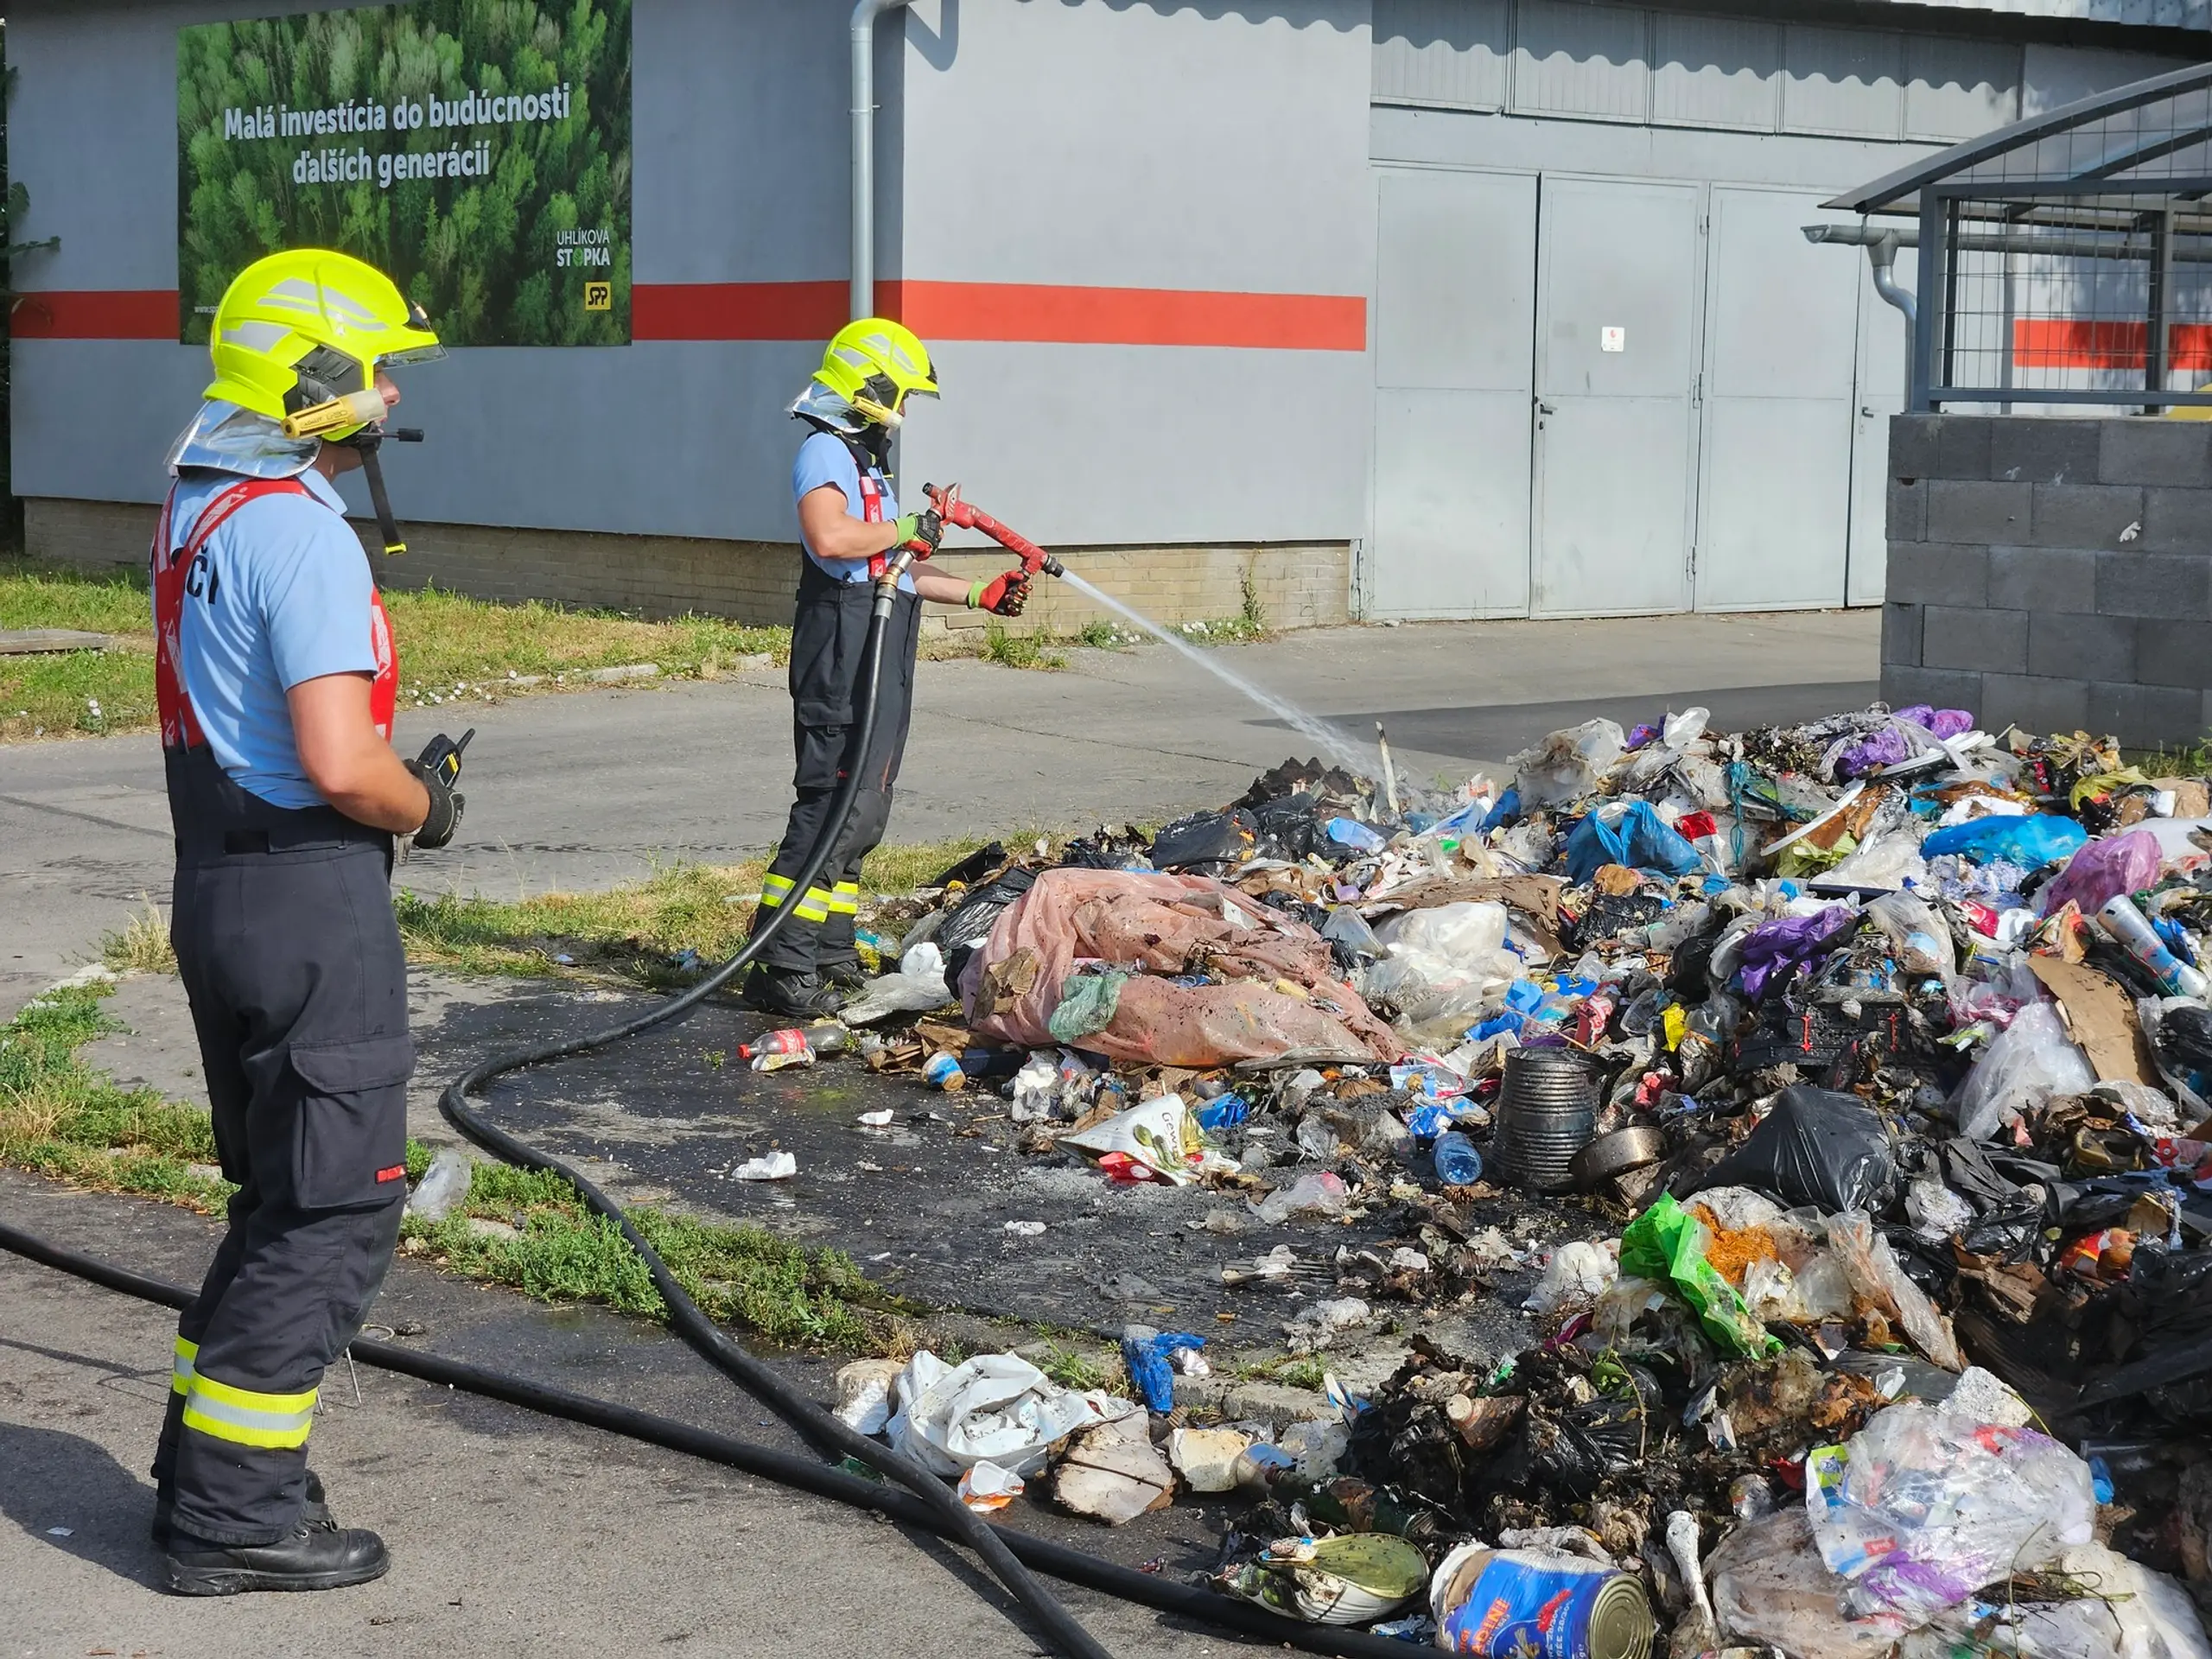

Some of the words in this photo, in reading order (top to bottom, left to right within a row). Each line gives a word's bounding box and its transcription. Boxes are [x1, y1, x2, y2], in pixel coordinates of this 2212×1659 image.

[224, 105, 276, 141] Malá
[281, 97, 386, 137] investícia
[393, 96, 423, 130] do
[429, 82, 570, 128] budúcnosti
[293, 146, 372, 184] ďalších
[378, 140, 491, 189] generácií
[556, 226, 610, 245] UHLÍKOVÁ
[588, 286, 608, 306] SPP
[1471, 1598, 1510, 1656] ADINI
